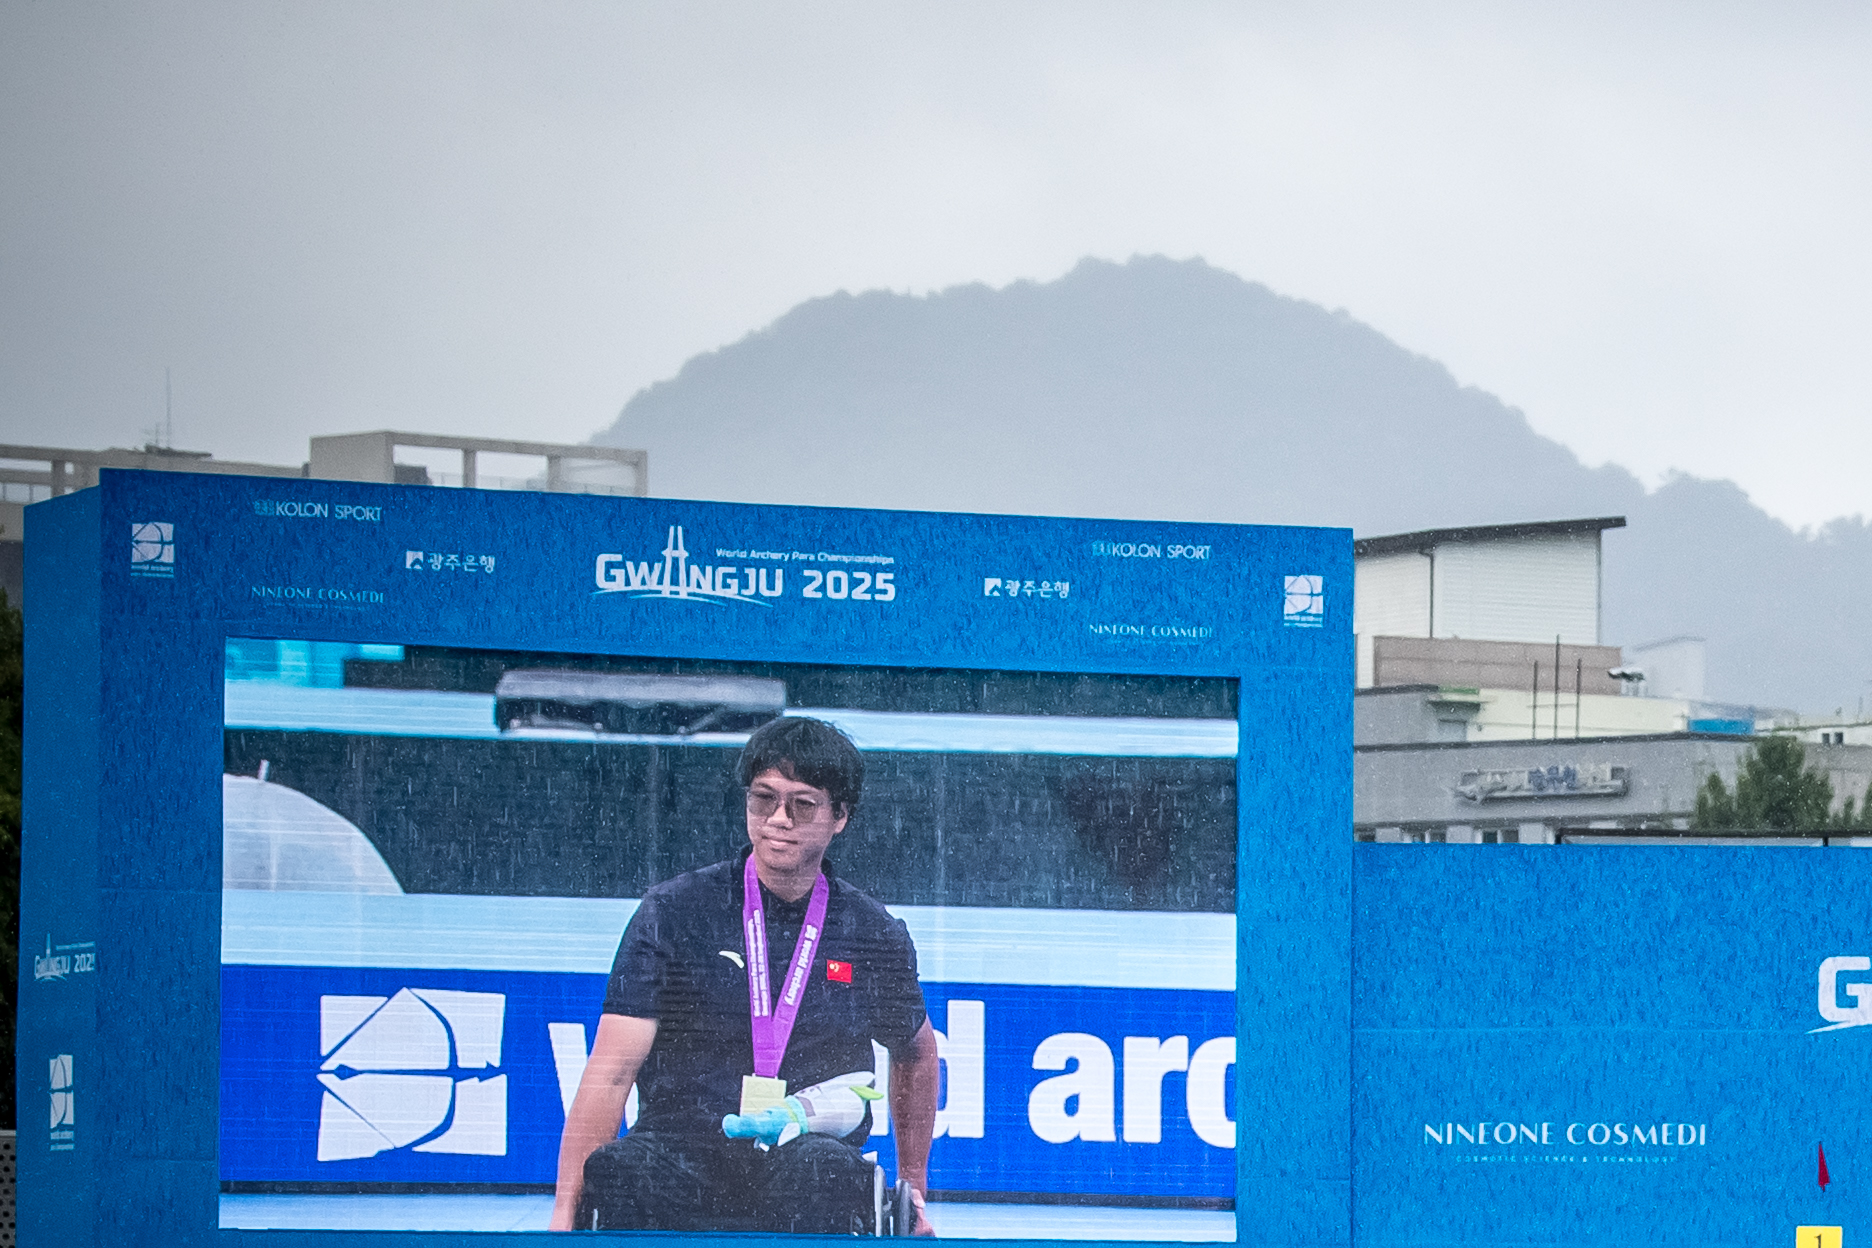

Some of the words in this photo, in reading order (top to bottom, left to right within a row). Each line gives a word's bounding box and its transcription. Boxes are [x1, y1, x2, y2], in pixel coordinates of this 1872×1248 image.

[275, 502, 328, 518] KOLON
[334, 505, 383, 521] SPORT
[1112, 542, 1160, 558] KOLON
[1167, 544, 1211, 560] SPORT
[427, 552, 496, 573] 광주은행
[595, 525, 784, 597] GWANGJU
[802, 569, 896, 600] 2025
[1424, 1121, 1555, 1145] NINEONE
[1566, 1122, 1706, 1146] COSMEDI
